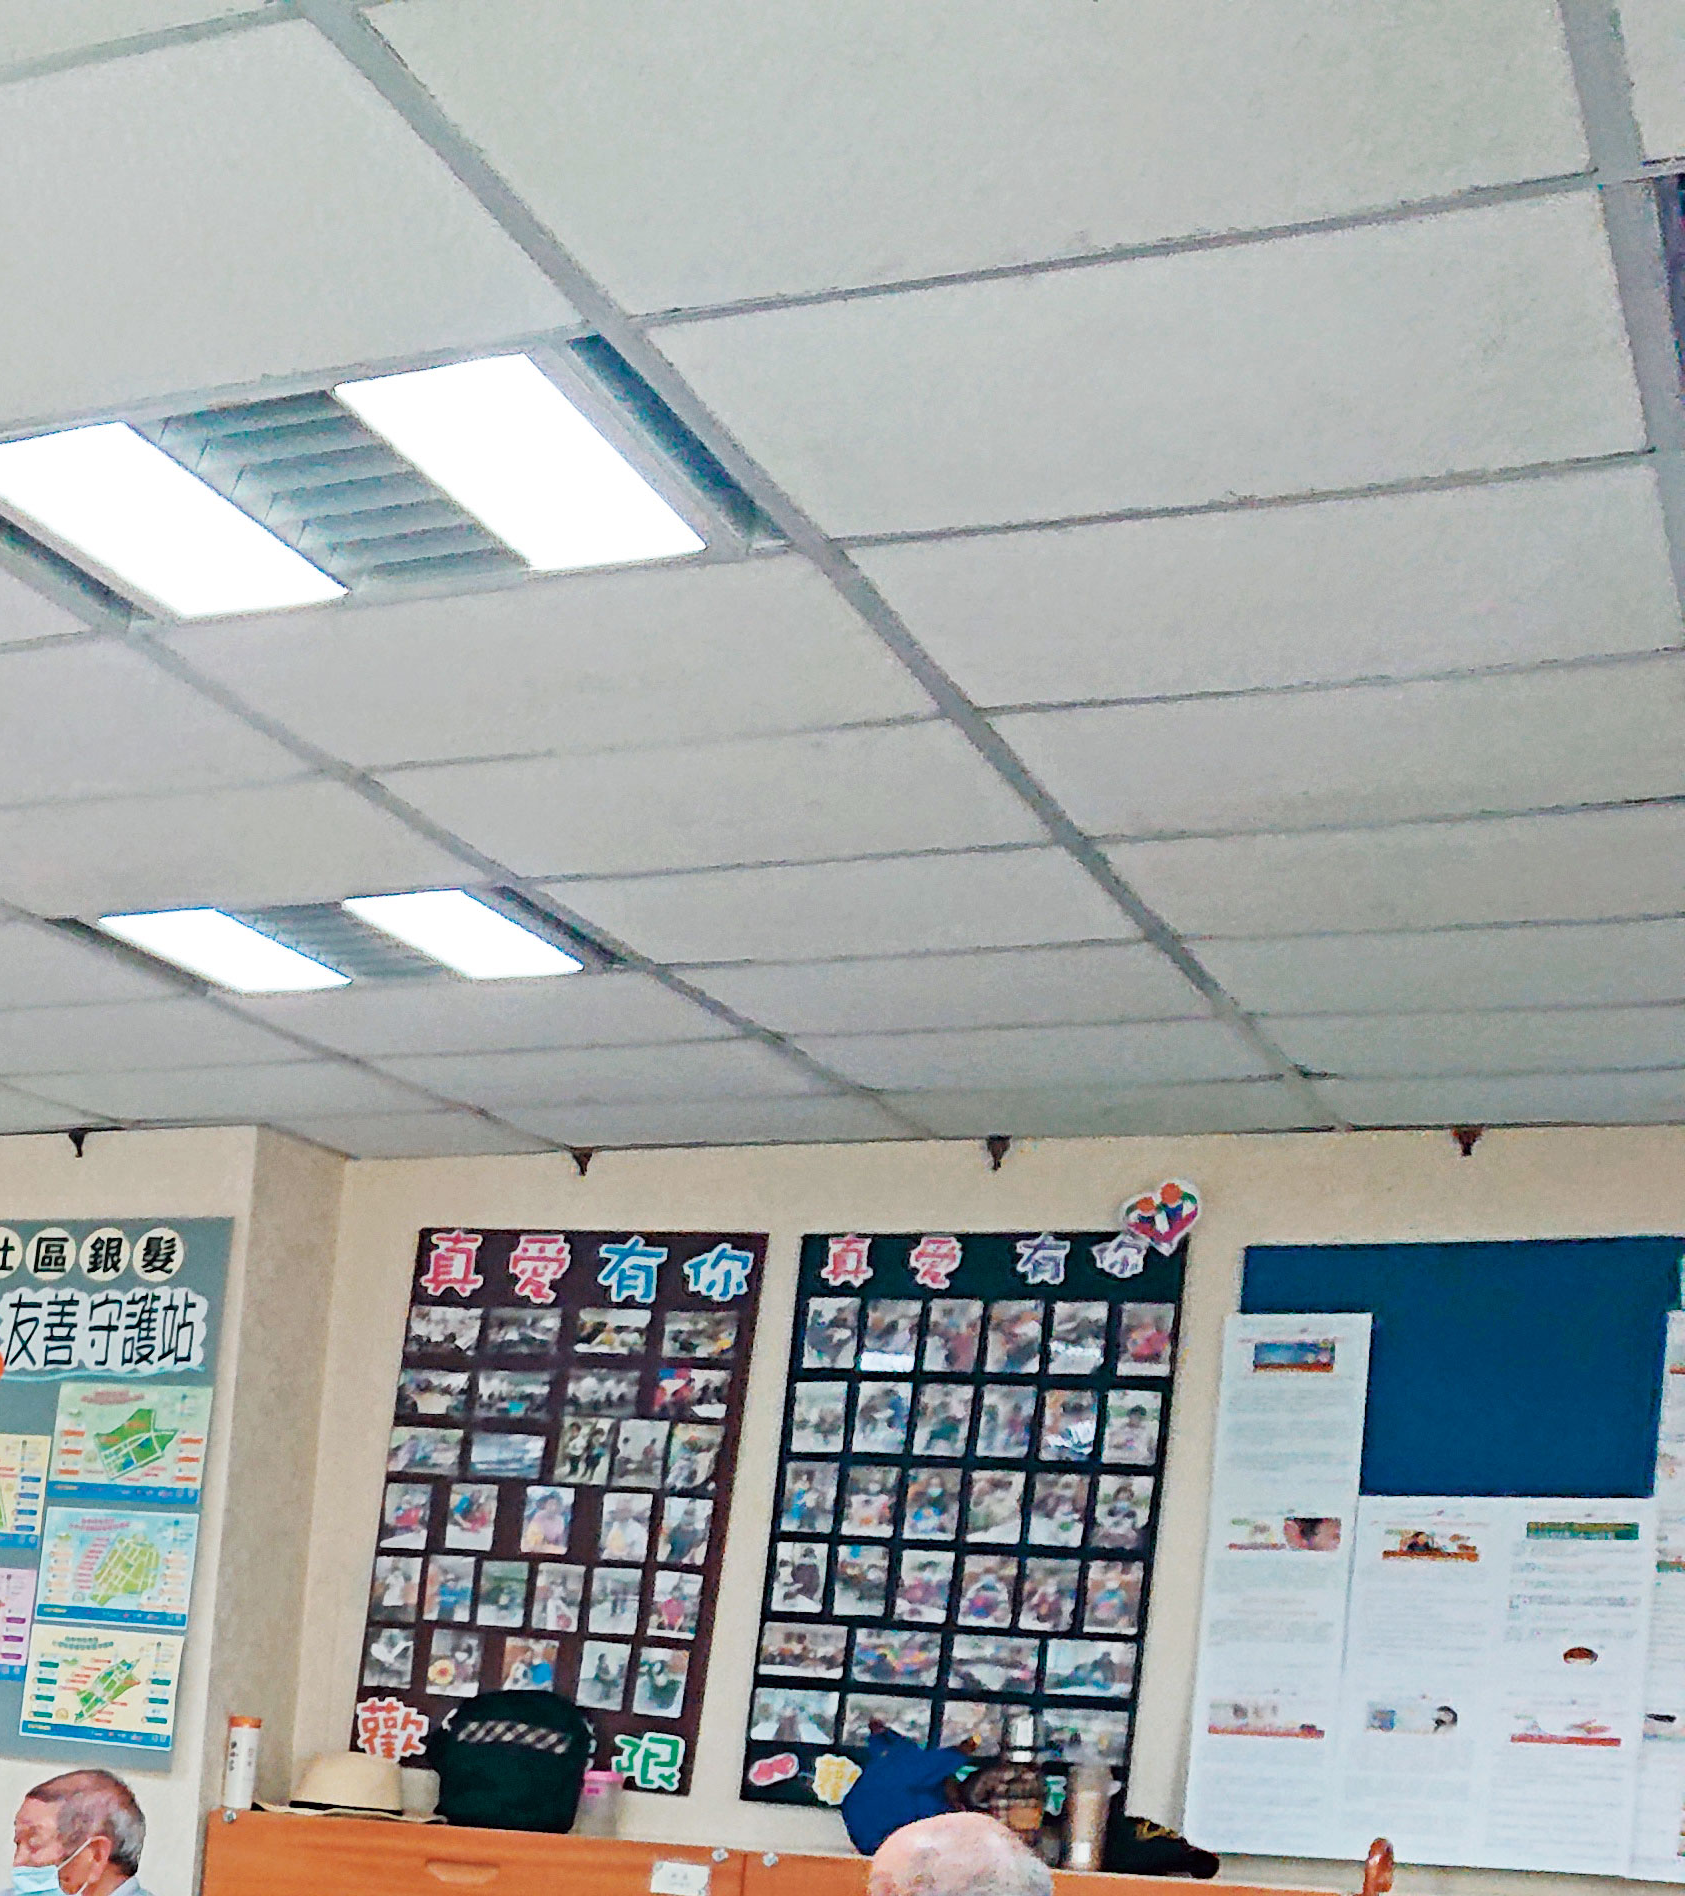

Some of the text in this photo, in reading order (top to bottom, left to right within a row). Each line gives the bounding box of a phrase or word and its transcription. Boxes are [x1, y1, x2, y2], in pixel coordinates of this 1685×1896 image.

[420, 1228, 754, 1304] 真愛有你
[819, 1232, 1147, 1288] 真愛有你
[3, 1293, 199, 1367] 友善守護站
